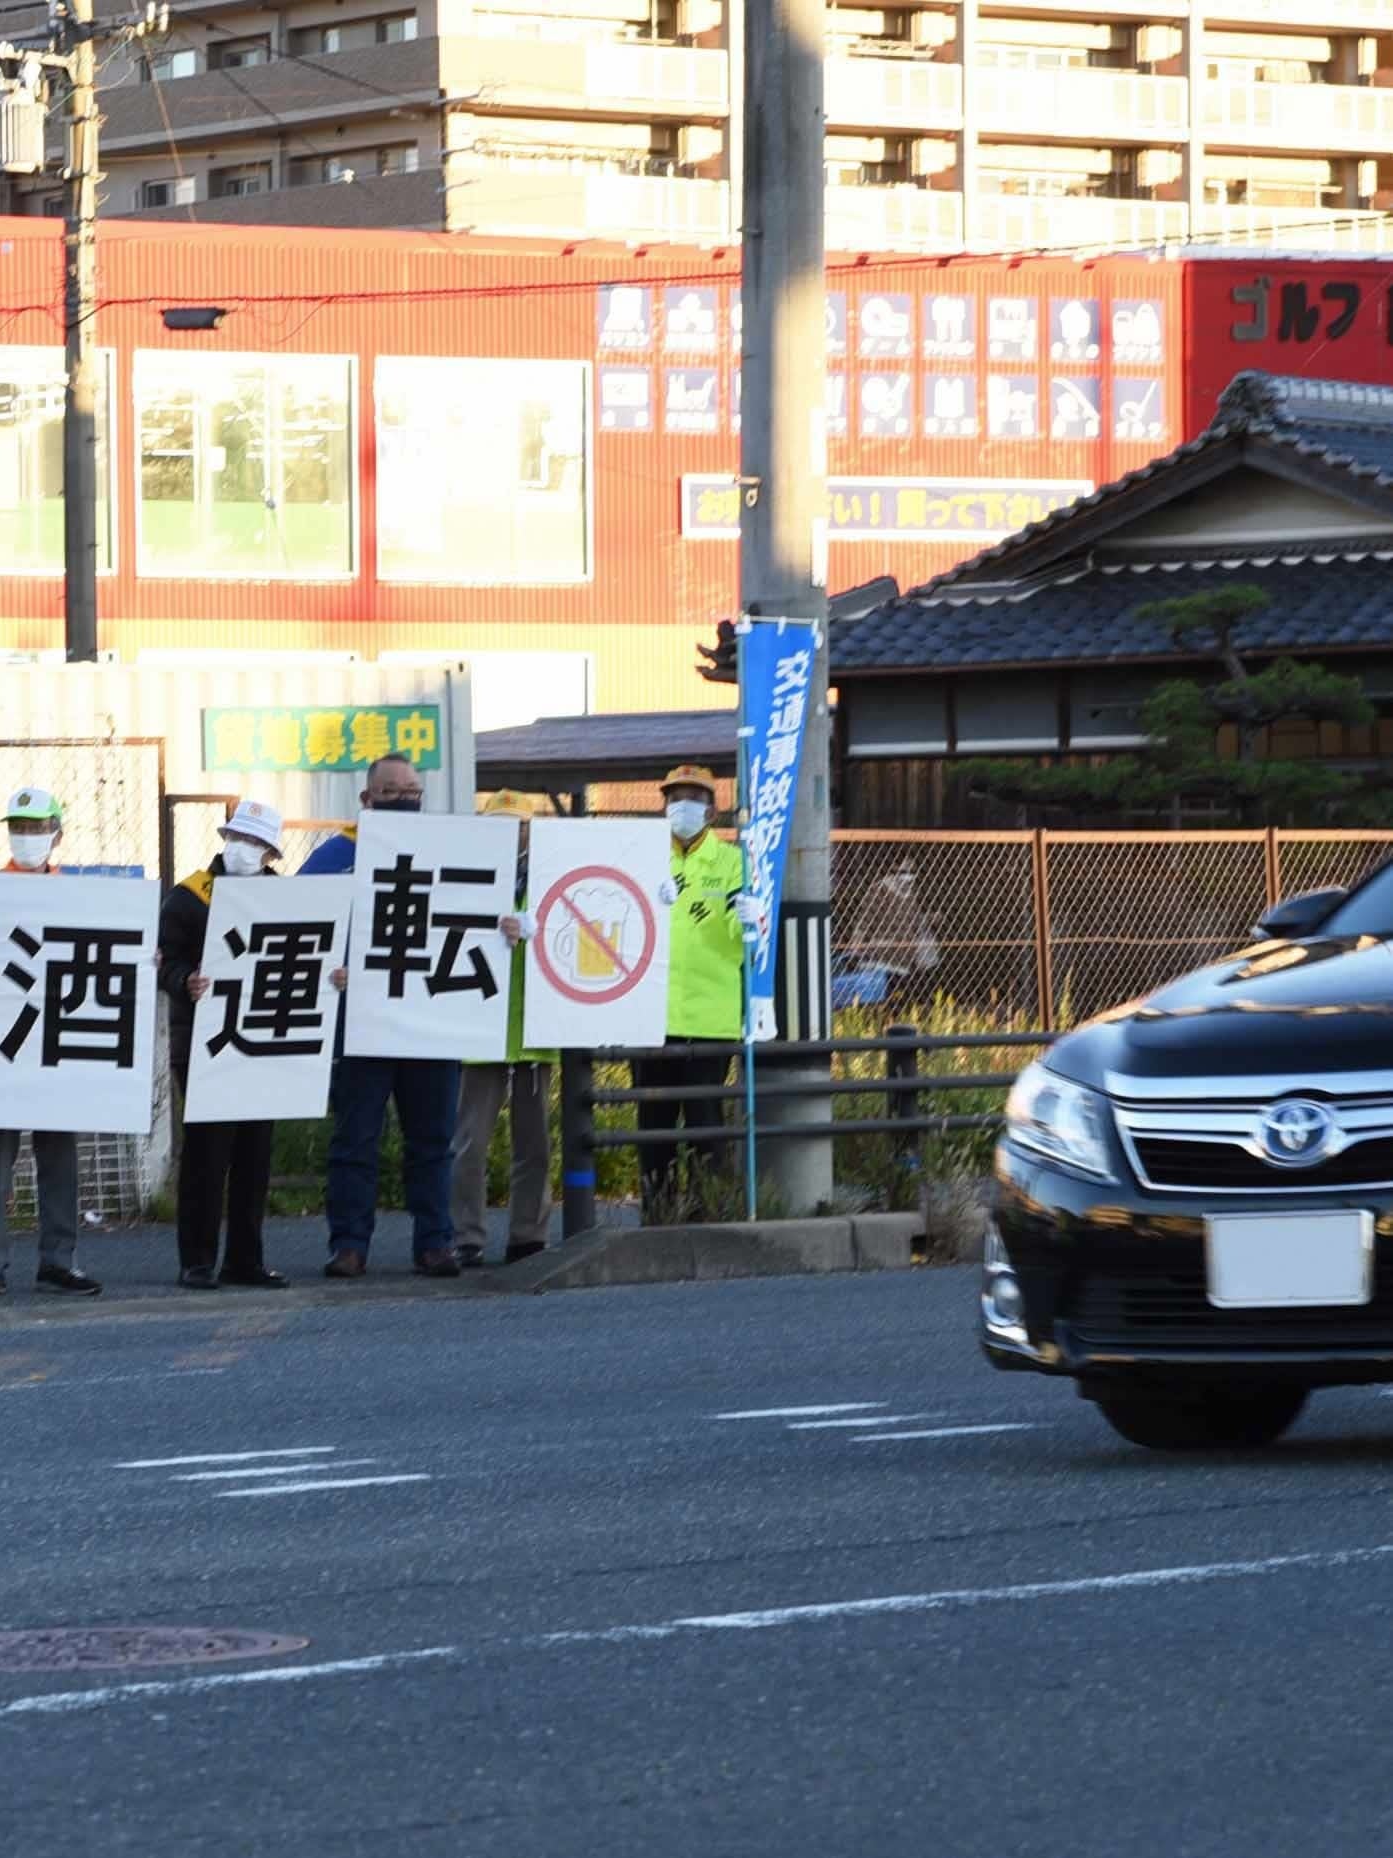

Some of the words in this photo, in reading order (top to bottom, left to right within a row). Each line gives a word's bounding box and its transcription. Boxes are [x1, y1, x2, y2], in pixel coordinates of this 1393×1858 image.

[1232, 275, 1393, 346] ゴルフ
[205, 919, 337, 1058] 運
[364, 853, 500, 1001] 転
